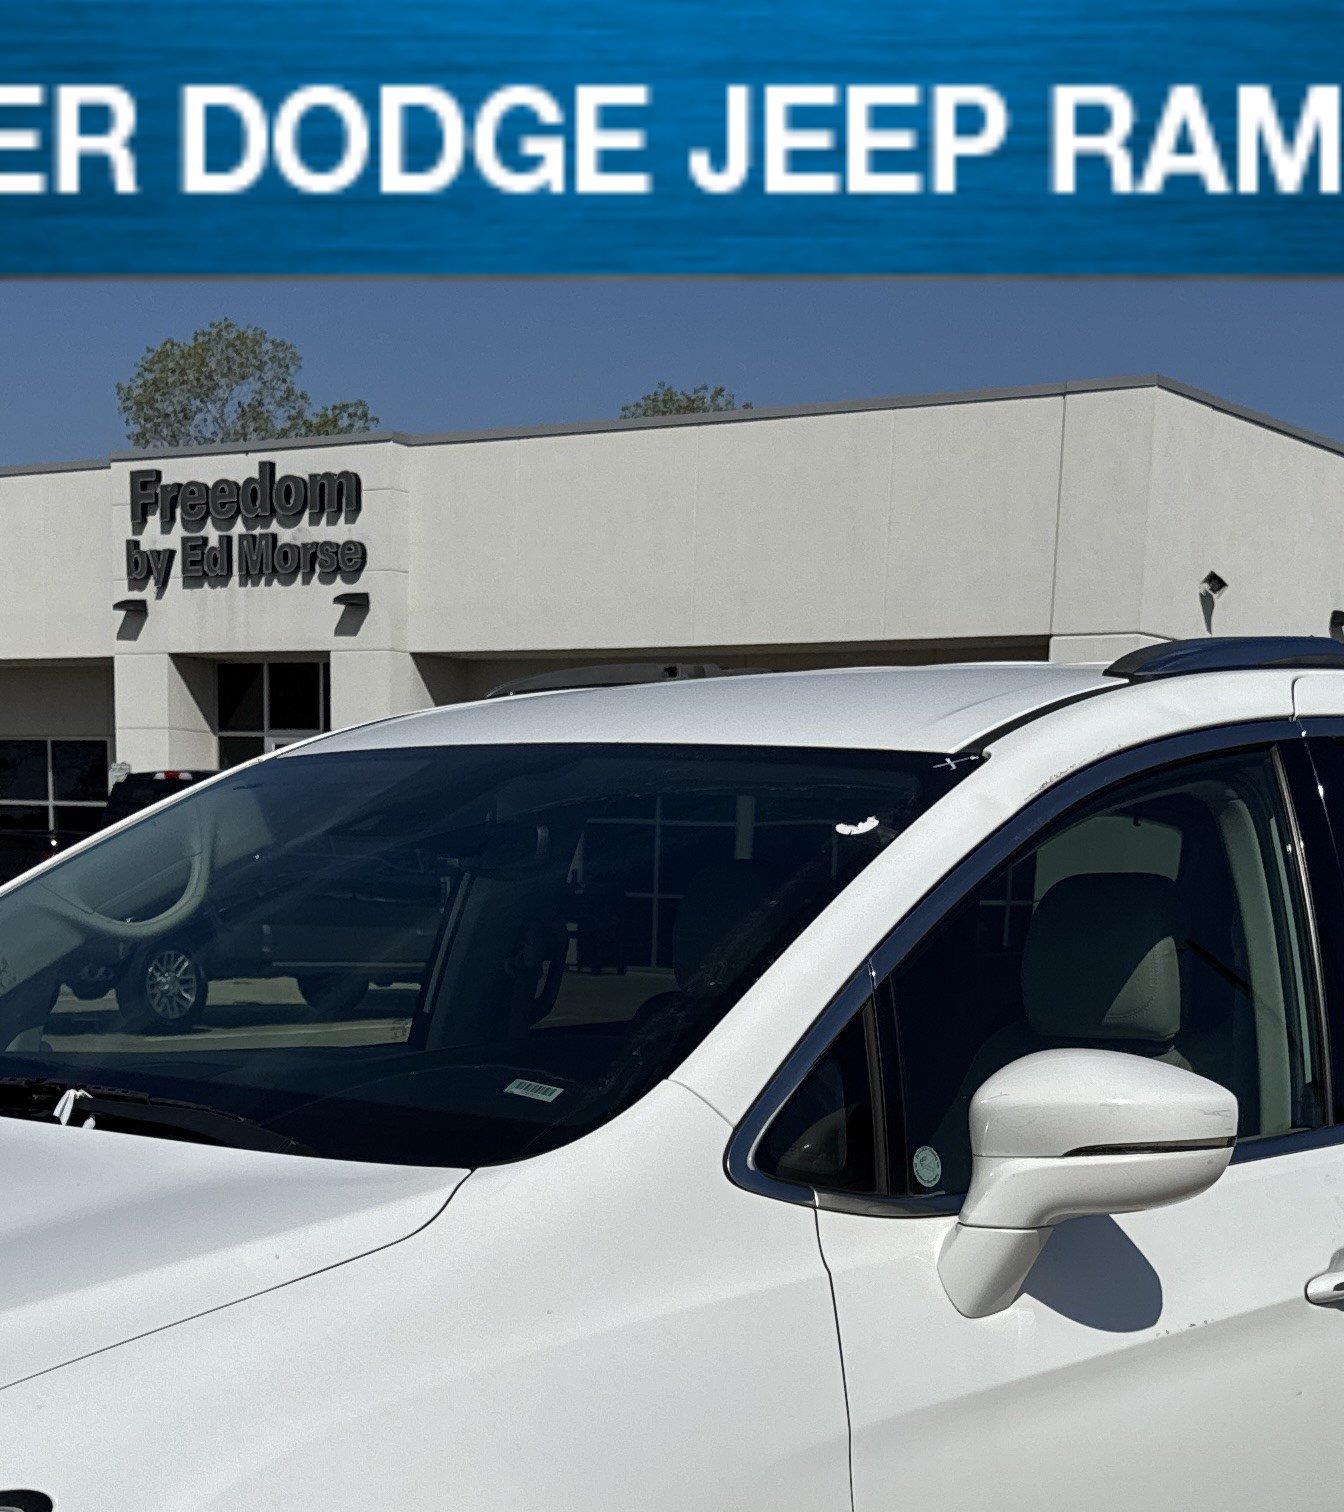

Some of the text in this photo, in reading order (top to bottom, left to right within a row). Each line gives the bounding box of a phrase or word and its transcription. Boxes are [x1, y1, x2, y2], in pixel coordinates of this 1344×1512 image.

[129, 461, 362, 530] Freedom
[126, 533, 367, 597] by Ed Morse
